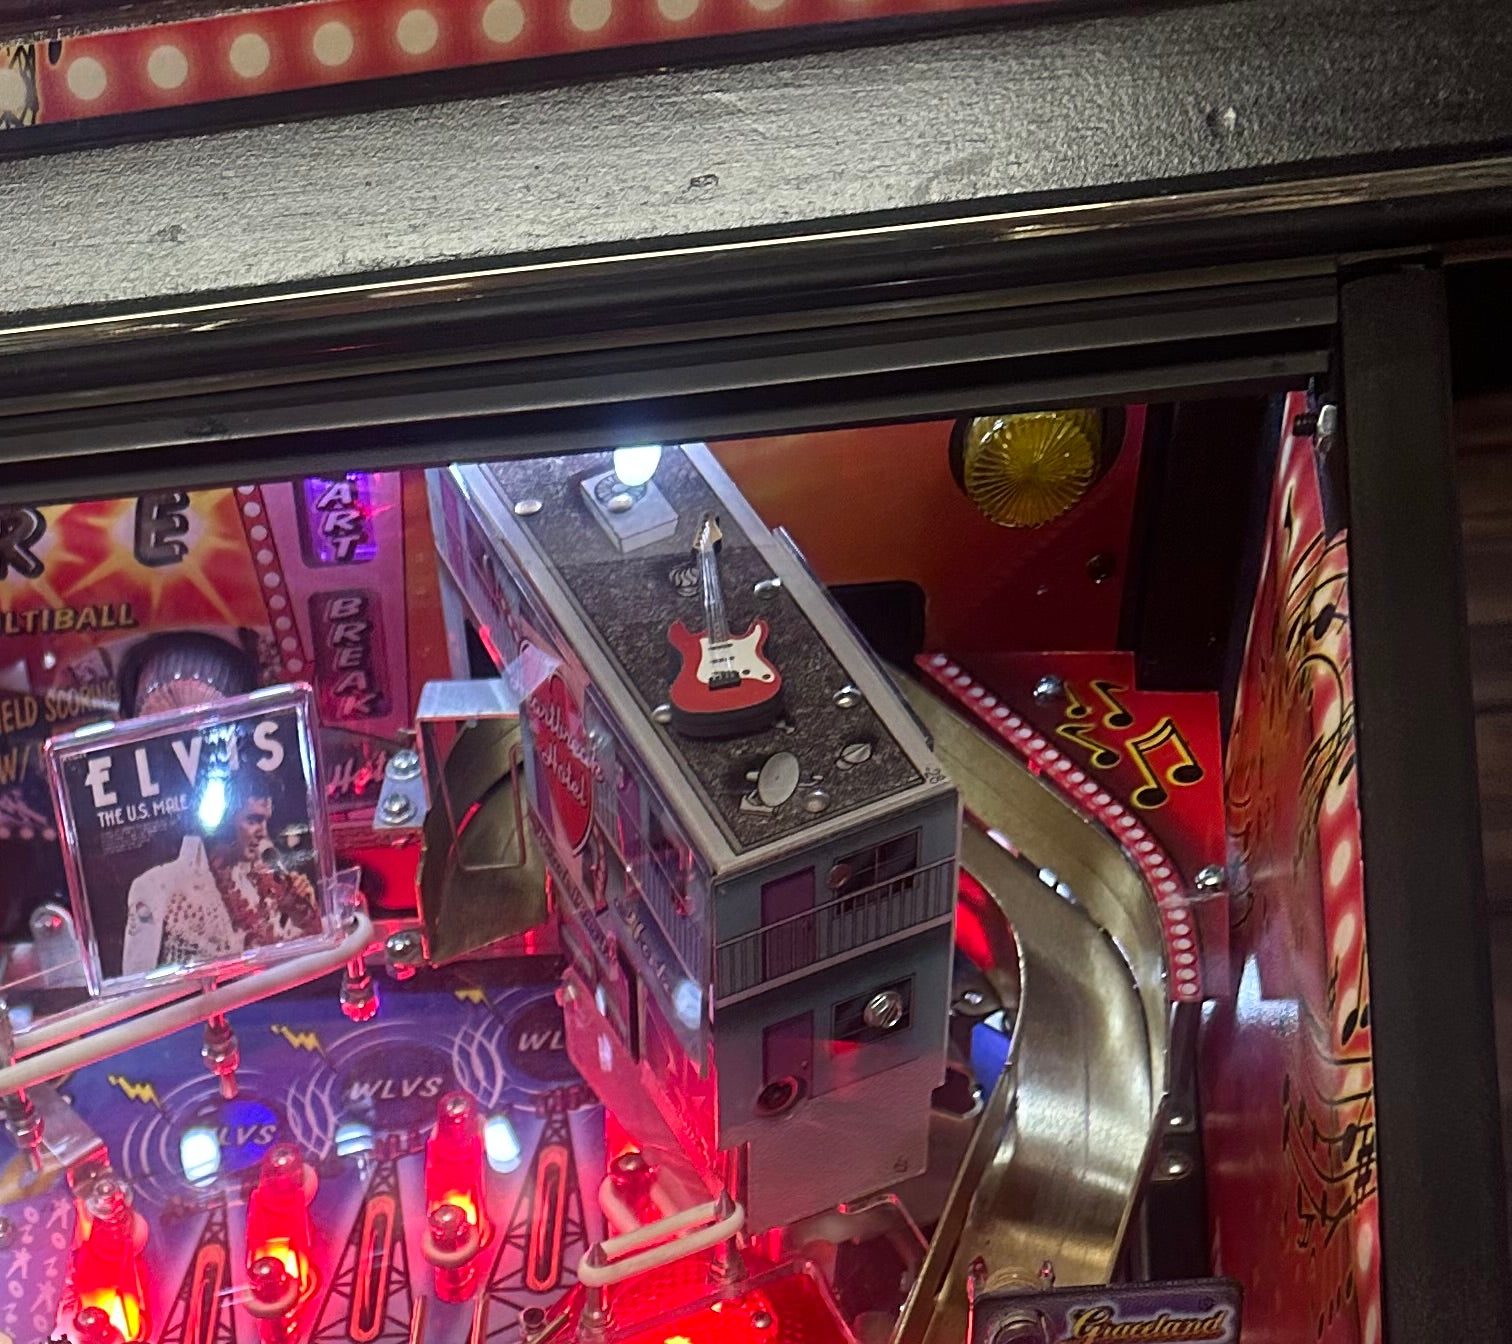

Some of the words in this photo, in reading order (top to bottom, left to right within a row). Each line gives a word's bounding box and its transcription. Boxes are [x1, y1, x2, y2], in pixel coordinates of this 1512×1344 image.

[328, 597, 382, 714] BREAK
[85, 721, 285, 808] ELVIS
[97, 807, 124, 828] THE
[126, 804, 150, 824] U.S.
[348, 1075, 444, 1101] WLVS
[212, 1121, 277, 1147] LVS
